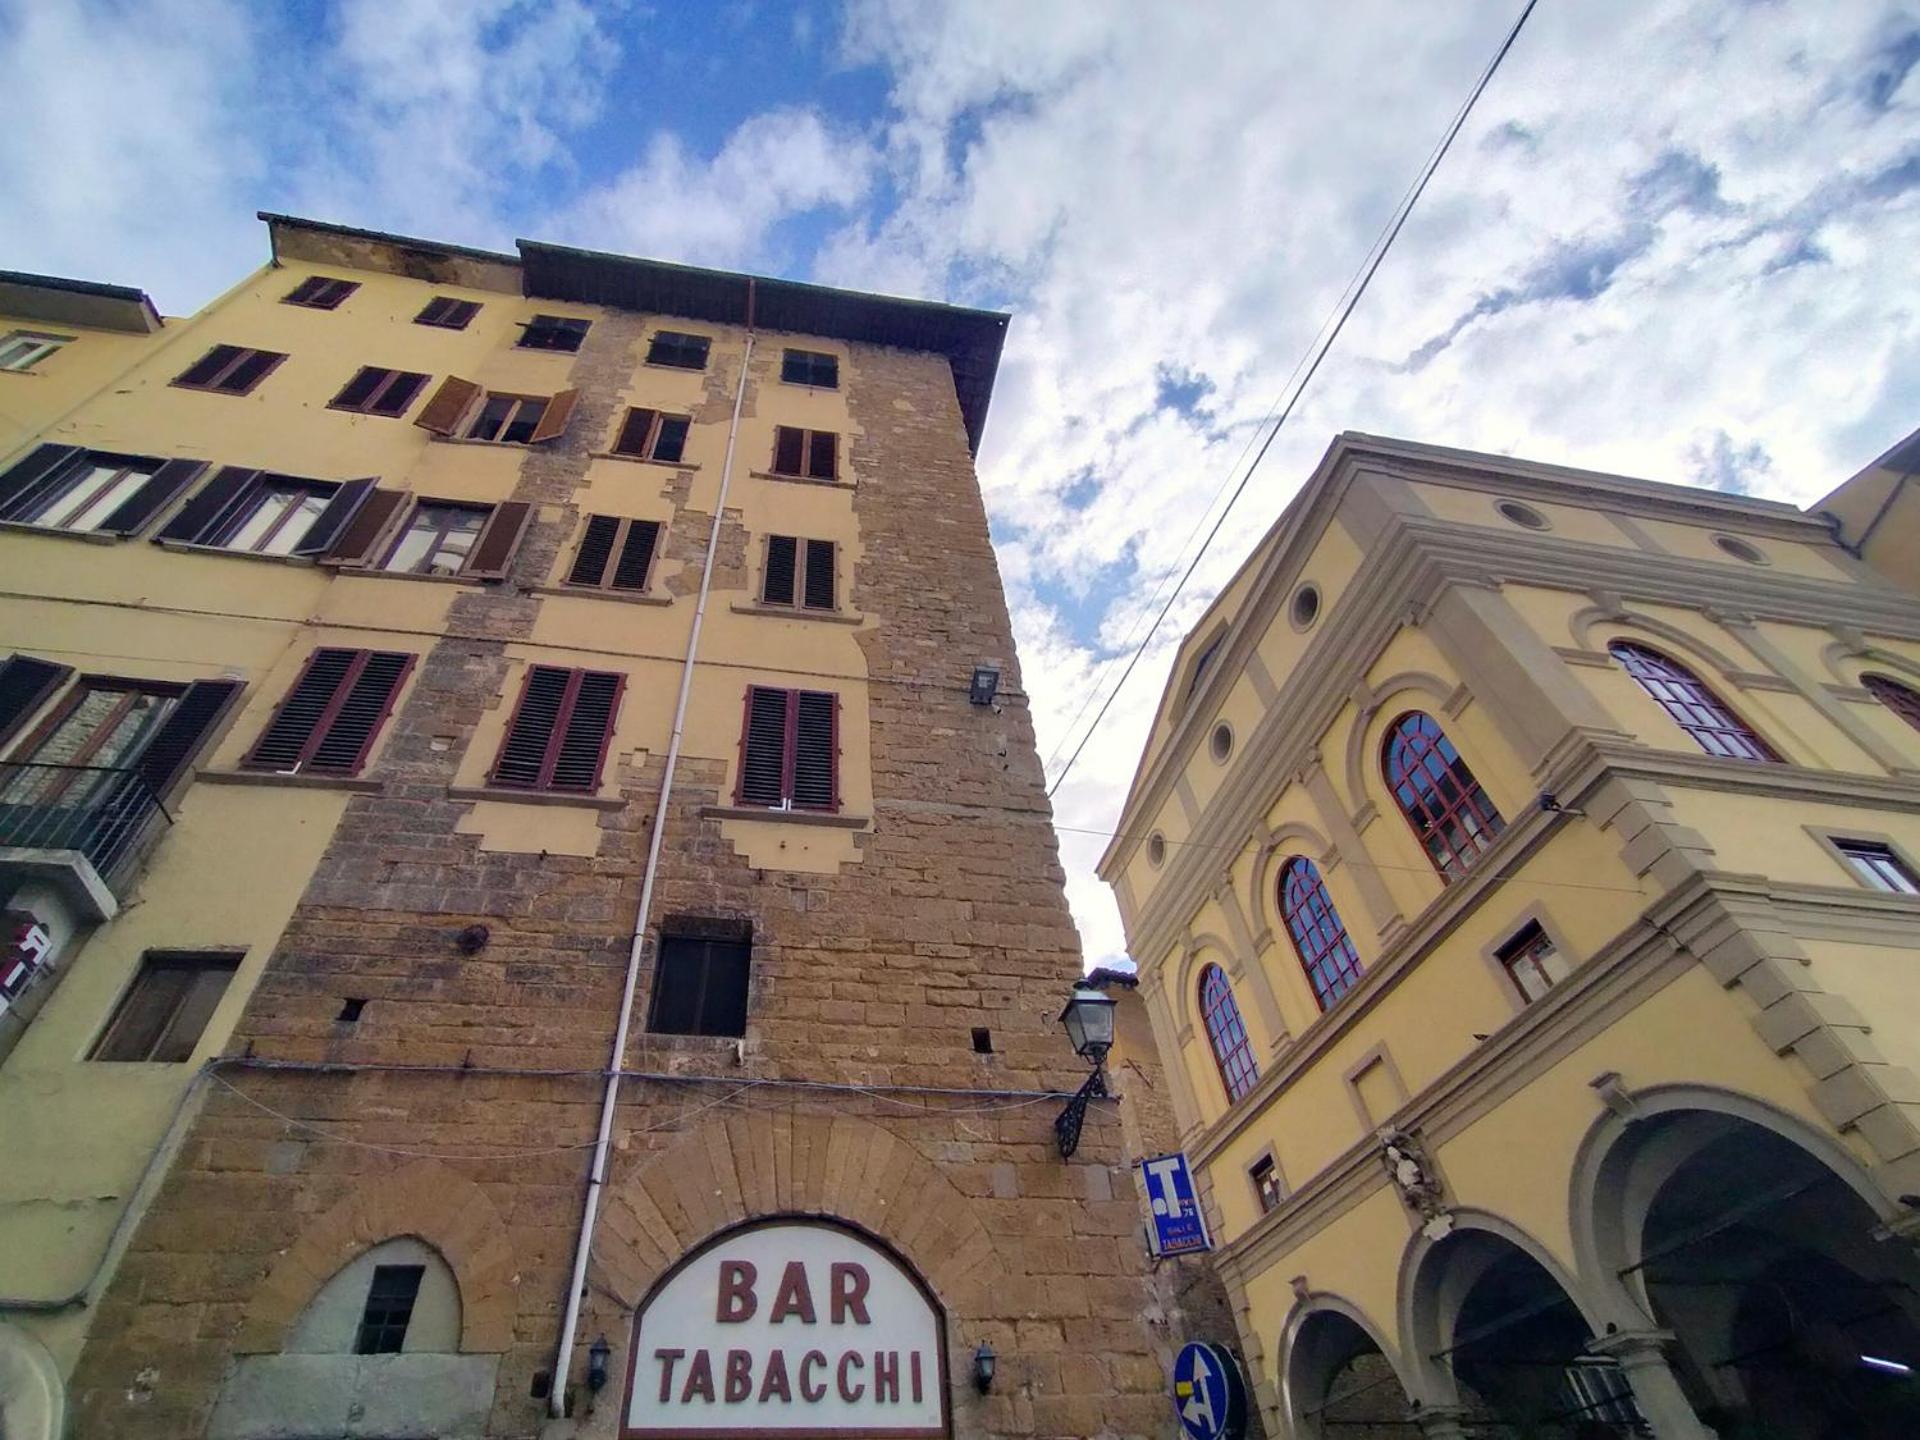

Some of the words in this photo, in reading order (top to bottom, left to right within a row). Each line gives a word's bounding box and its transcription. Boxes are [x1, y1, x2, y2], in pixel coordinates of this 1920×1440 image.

[1148, 1158, 1181, 1218] T
[716, 1260, 871, 1325] BAR
[654, 1349, 923, 1403] TABACCHI
